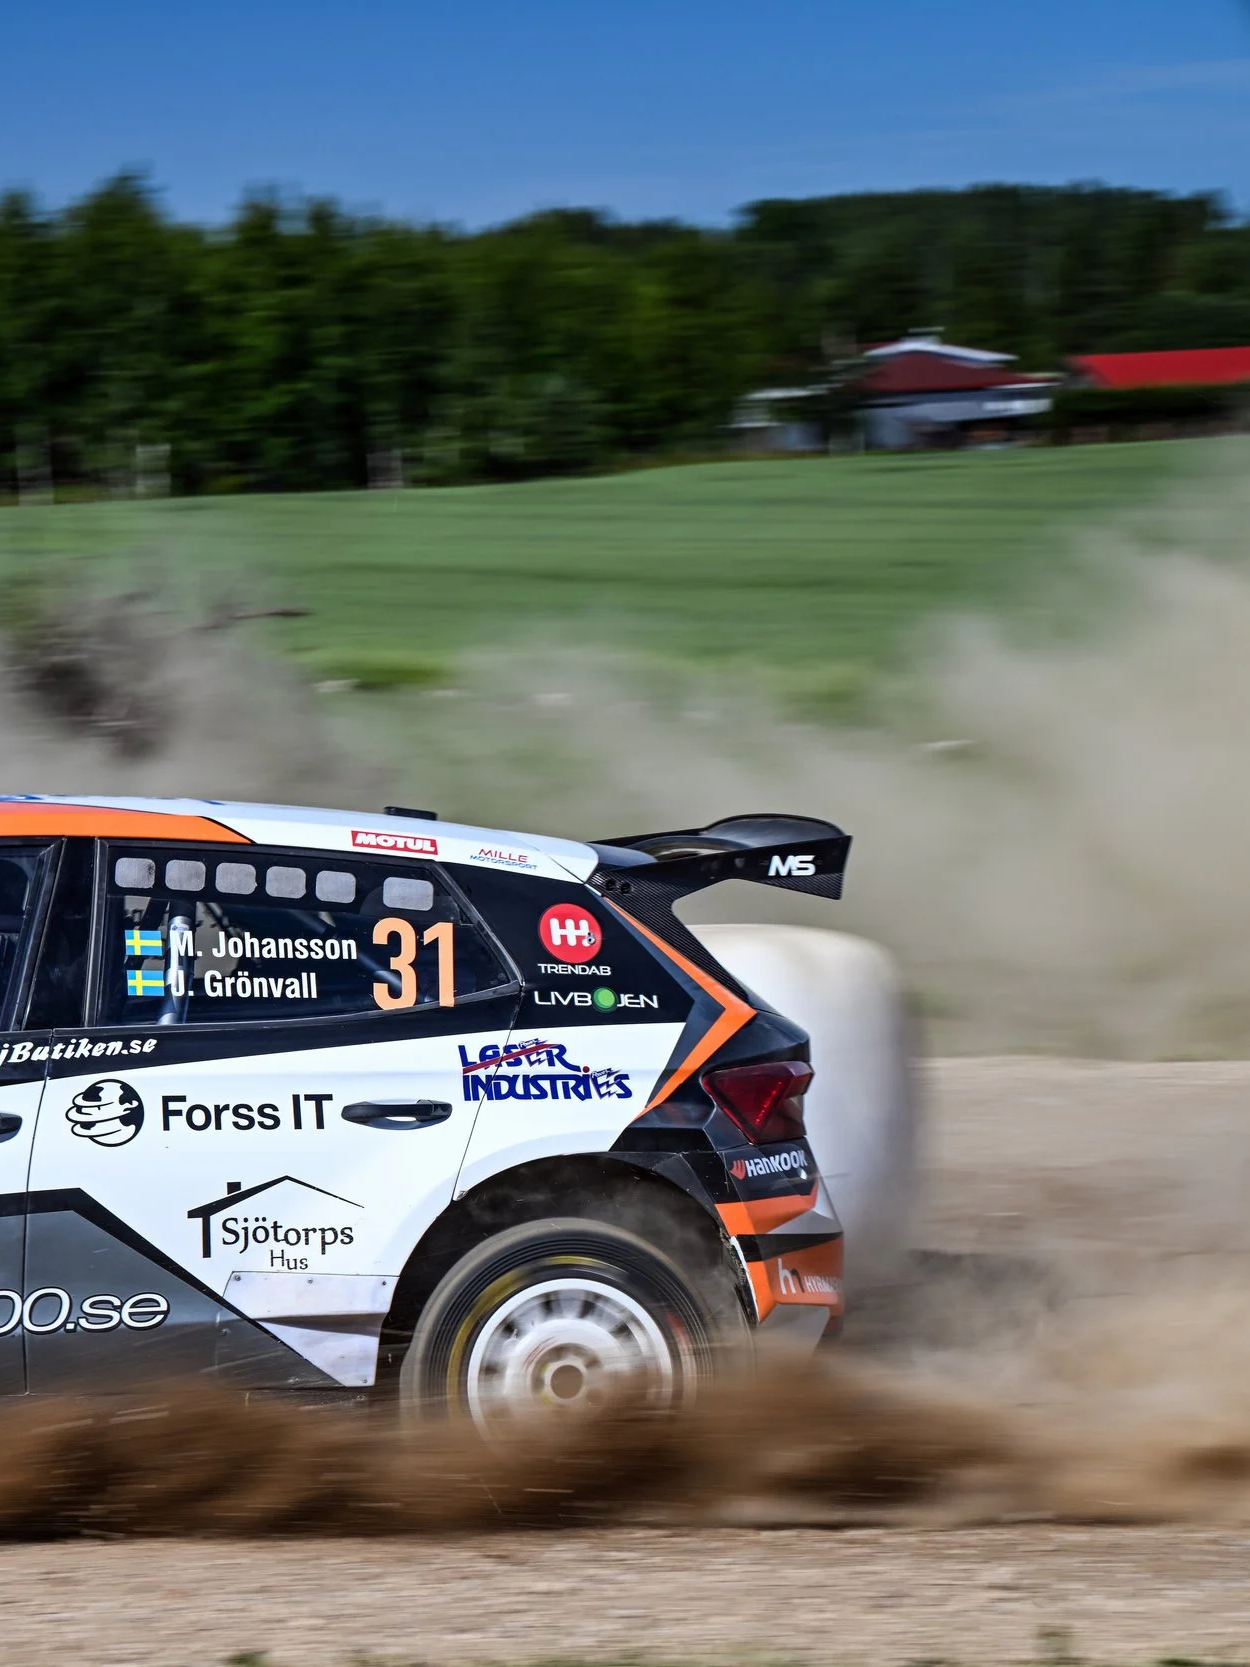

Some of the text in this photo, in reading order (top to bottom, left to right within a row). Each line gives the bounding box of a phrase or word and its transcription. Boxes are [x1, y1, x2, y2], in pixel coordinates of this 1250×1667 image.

[353, 832, 437, 854] MOTUL
[470, 855, 537, 870] MOTORSPORT
[479, 848, 528, 863] MILLE
[768, 855, 816, 876] MS
[170, 930, 357, 960] M. Johansson
[372, 917, 455, 1010] 31
[538, 963, 611, 976] TRENDAB
[204, 970, 318, 999] Grönvall
[162, 1094, 333, 1131] Forss IT
[222, 1217, 354, 1255] Sjötorps
[269, 1249, 309, 1270] Hus
